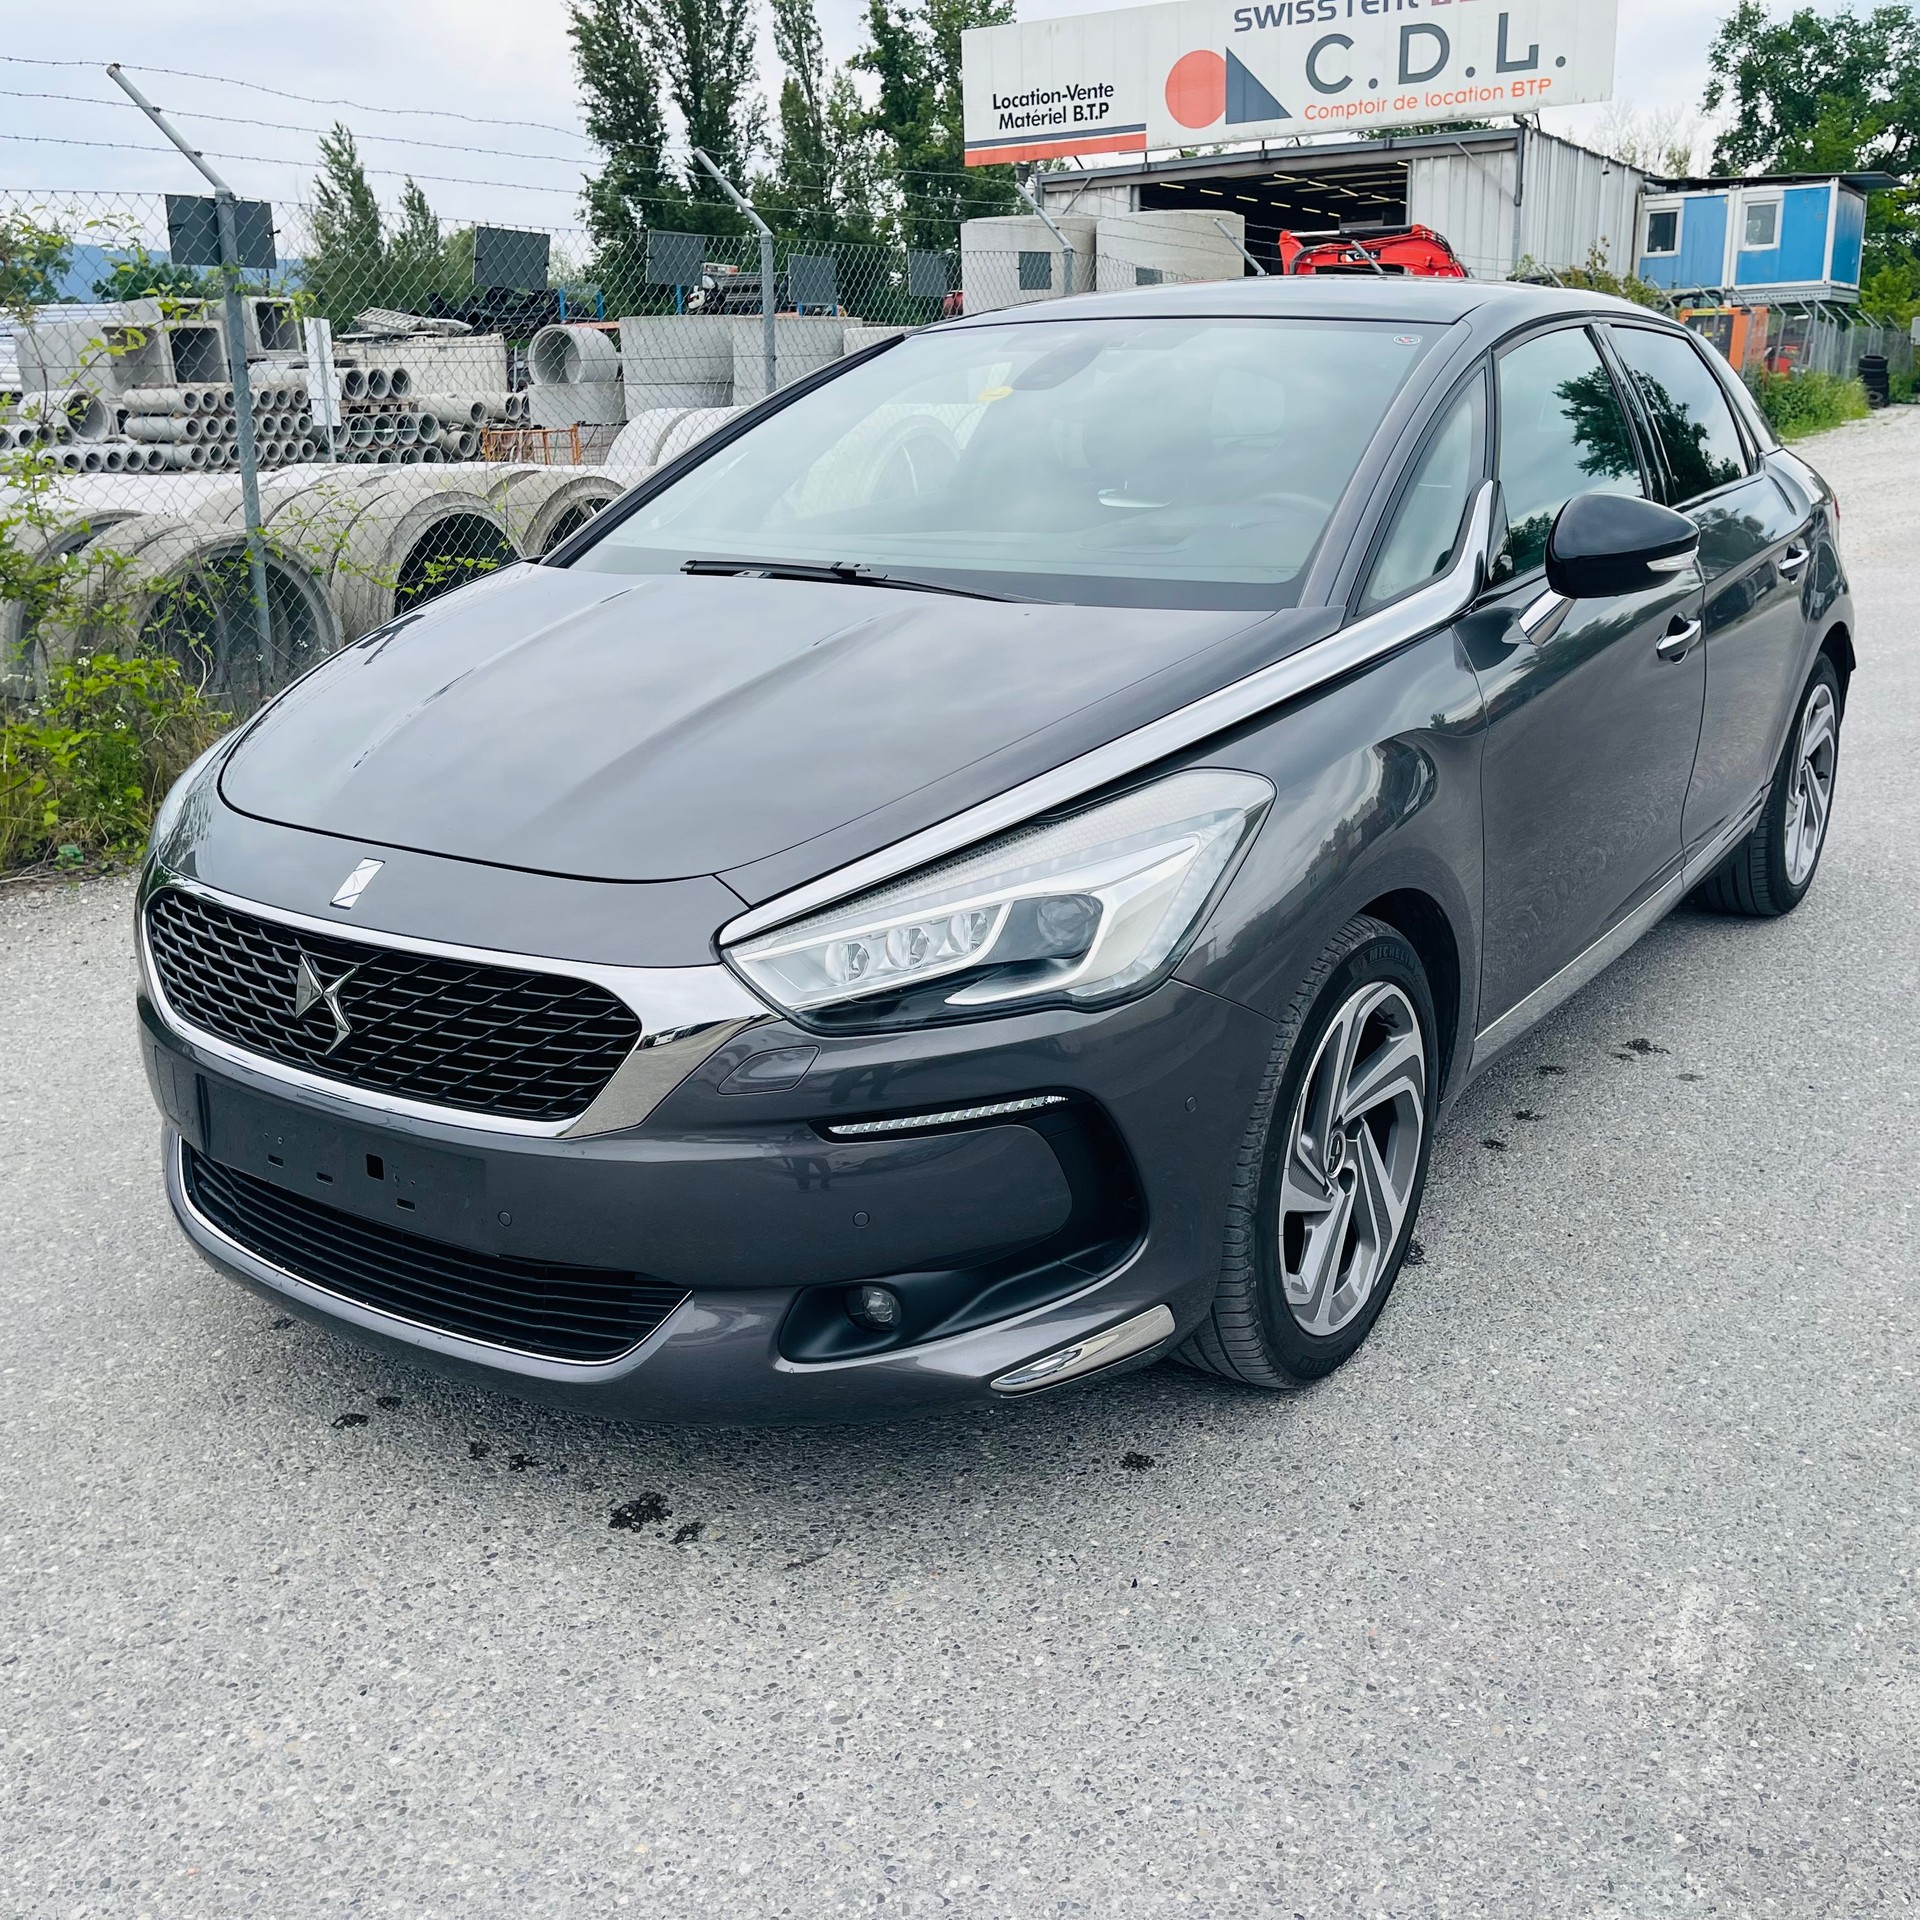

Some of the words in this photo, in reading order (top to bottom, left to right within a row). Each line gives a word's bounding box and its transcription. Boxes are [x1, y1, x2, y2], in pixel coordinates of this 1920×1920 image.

[992, 82, 1115, 110] Location-Vente
[1304, 97, 1388, 120] Comptoir
[1393, 94, 1418, 111] de
[1425, 84, 1504, 107] location
[1511, 78, 1552, 98] BTP
[998, 105, 1067, 130] Matériel
[1073, 102, 1110, 122] B.T.P
[1369, 945, 1418, 969] MICHELIN
